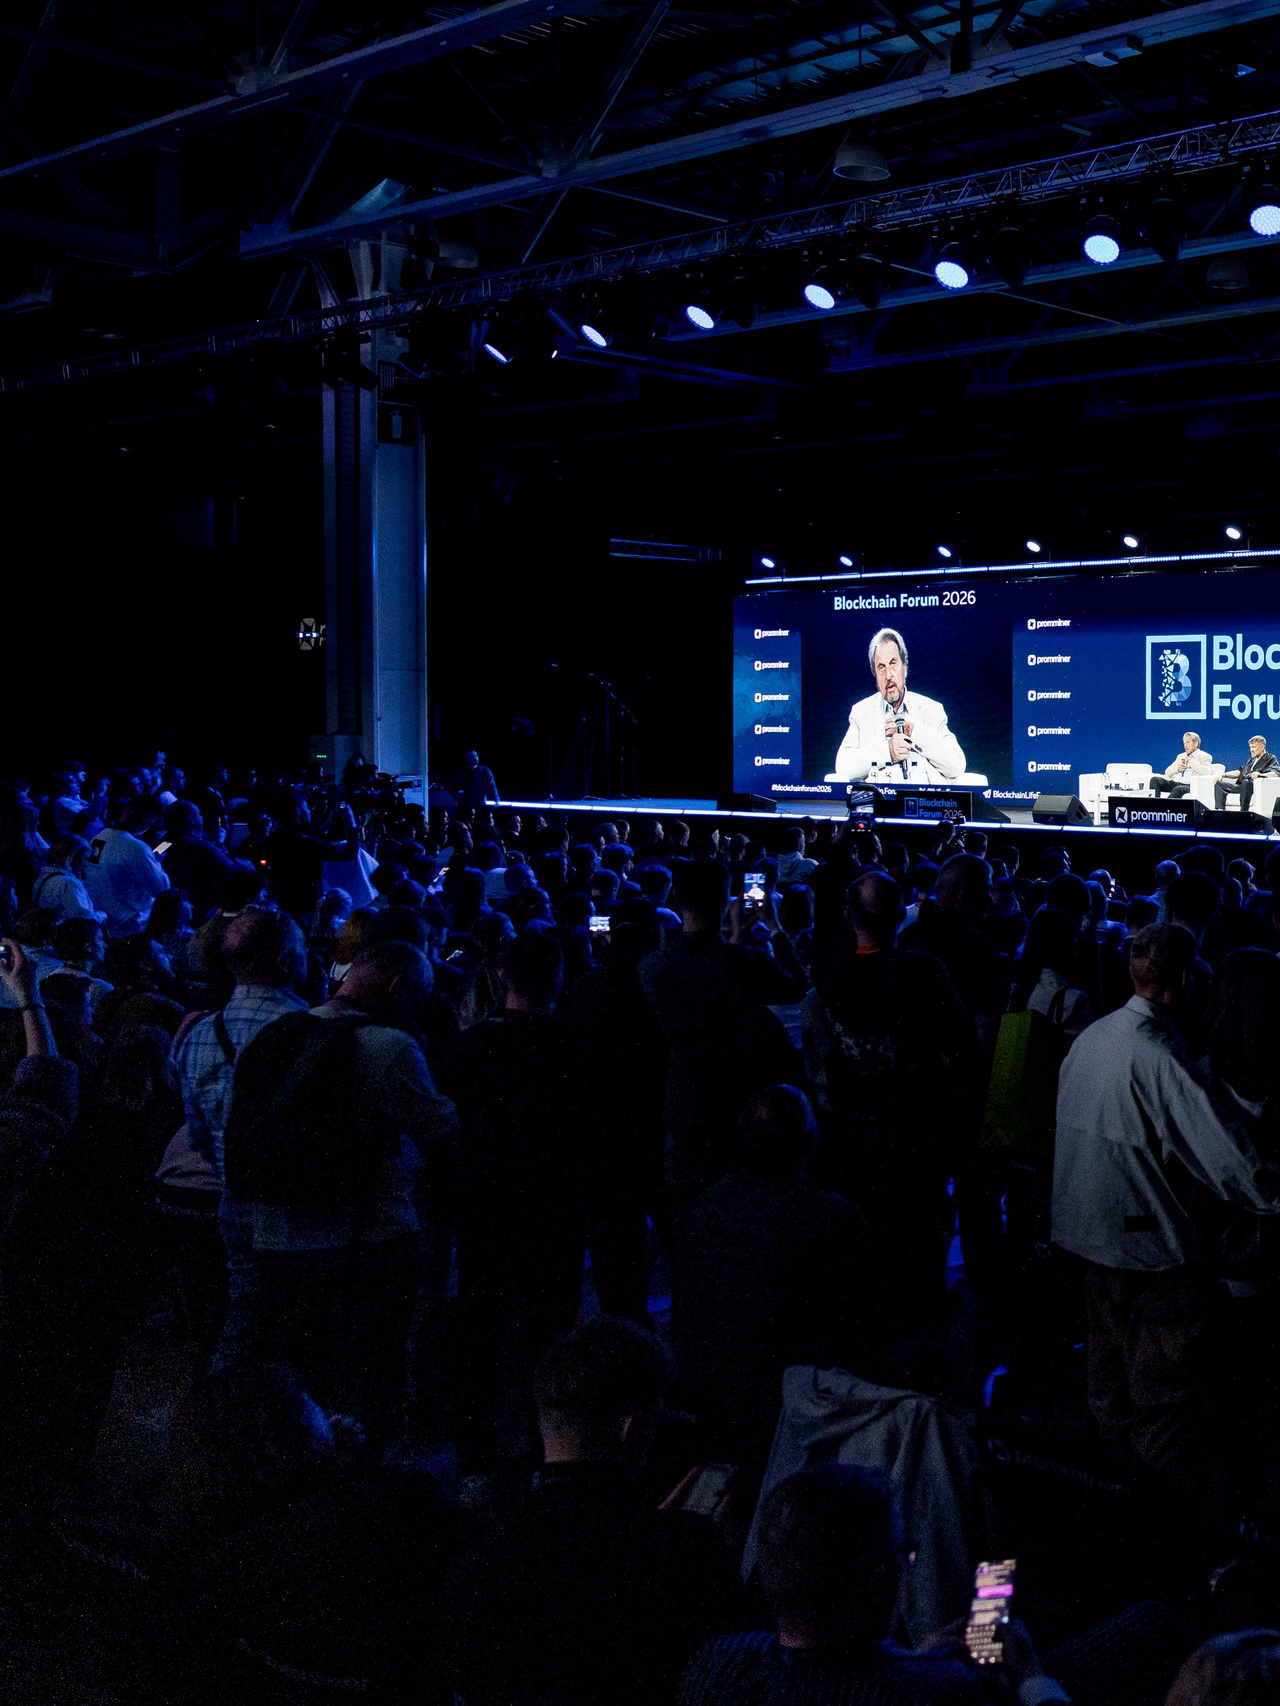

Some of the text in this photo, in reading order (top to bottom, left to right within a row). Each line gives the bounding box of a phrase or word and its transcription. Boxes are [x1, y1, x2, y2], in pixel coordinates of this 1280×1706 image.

[834, 590, 977, 610] Blockchain Forum 2026
[1036, 618, 1071, 628] promminer
[1036, 654, 1071, 664] promminer
[1036, 690, 1071, 700] promminer
[1036, 726, 1071, 736] promminer
[1036, 762, 1071, 772] promminer
[919, 797, 958, 808] Blockchain
[919, 808, 942, 818] Forum
[1130, 809, 1188, 823] promminer
